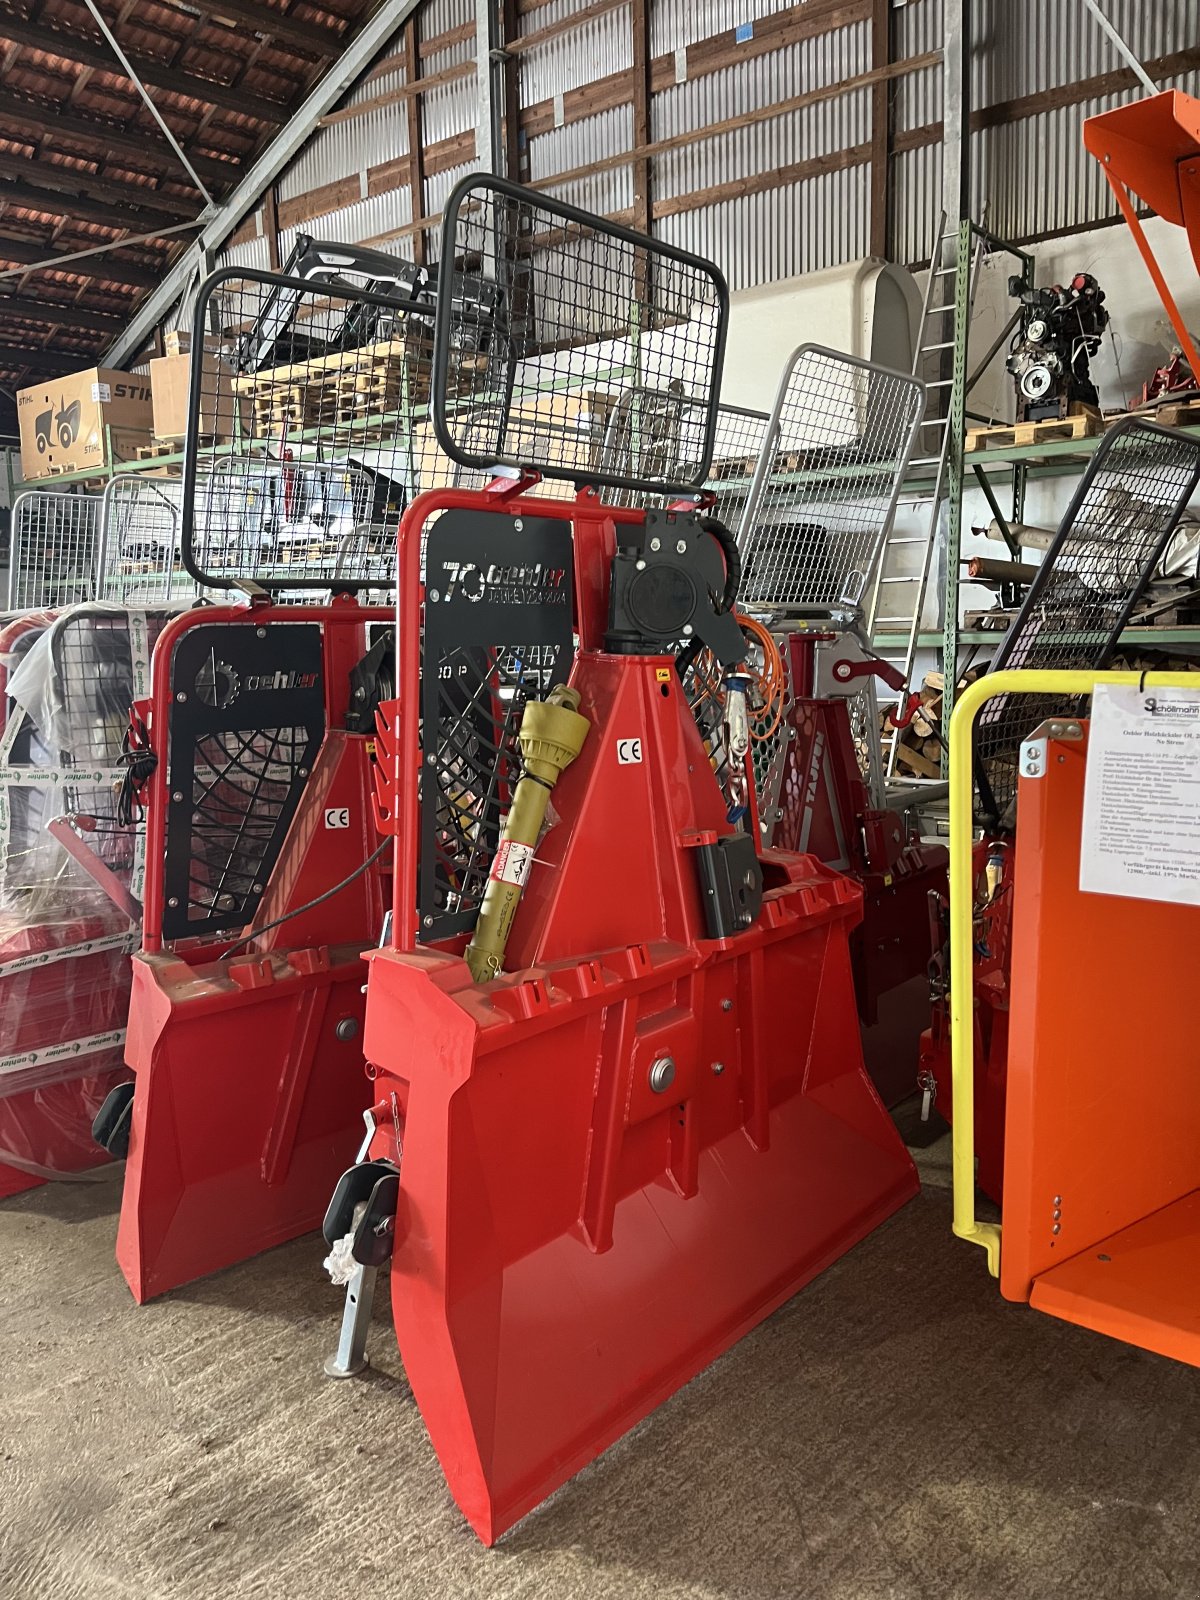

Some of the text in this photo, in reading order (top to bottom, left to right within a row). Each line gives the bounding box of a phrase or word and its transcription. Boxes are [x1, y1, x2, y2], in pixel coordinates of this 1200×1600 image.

[19, 395, 34, 406] STIHL
[243, 670, 318, 691] oehler
[806, 731, 824, 803] TAJFUN
